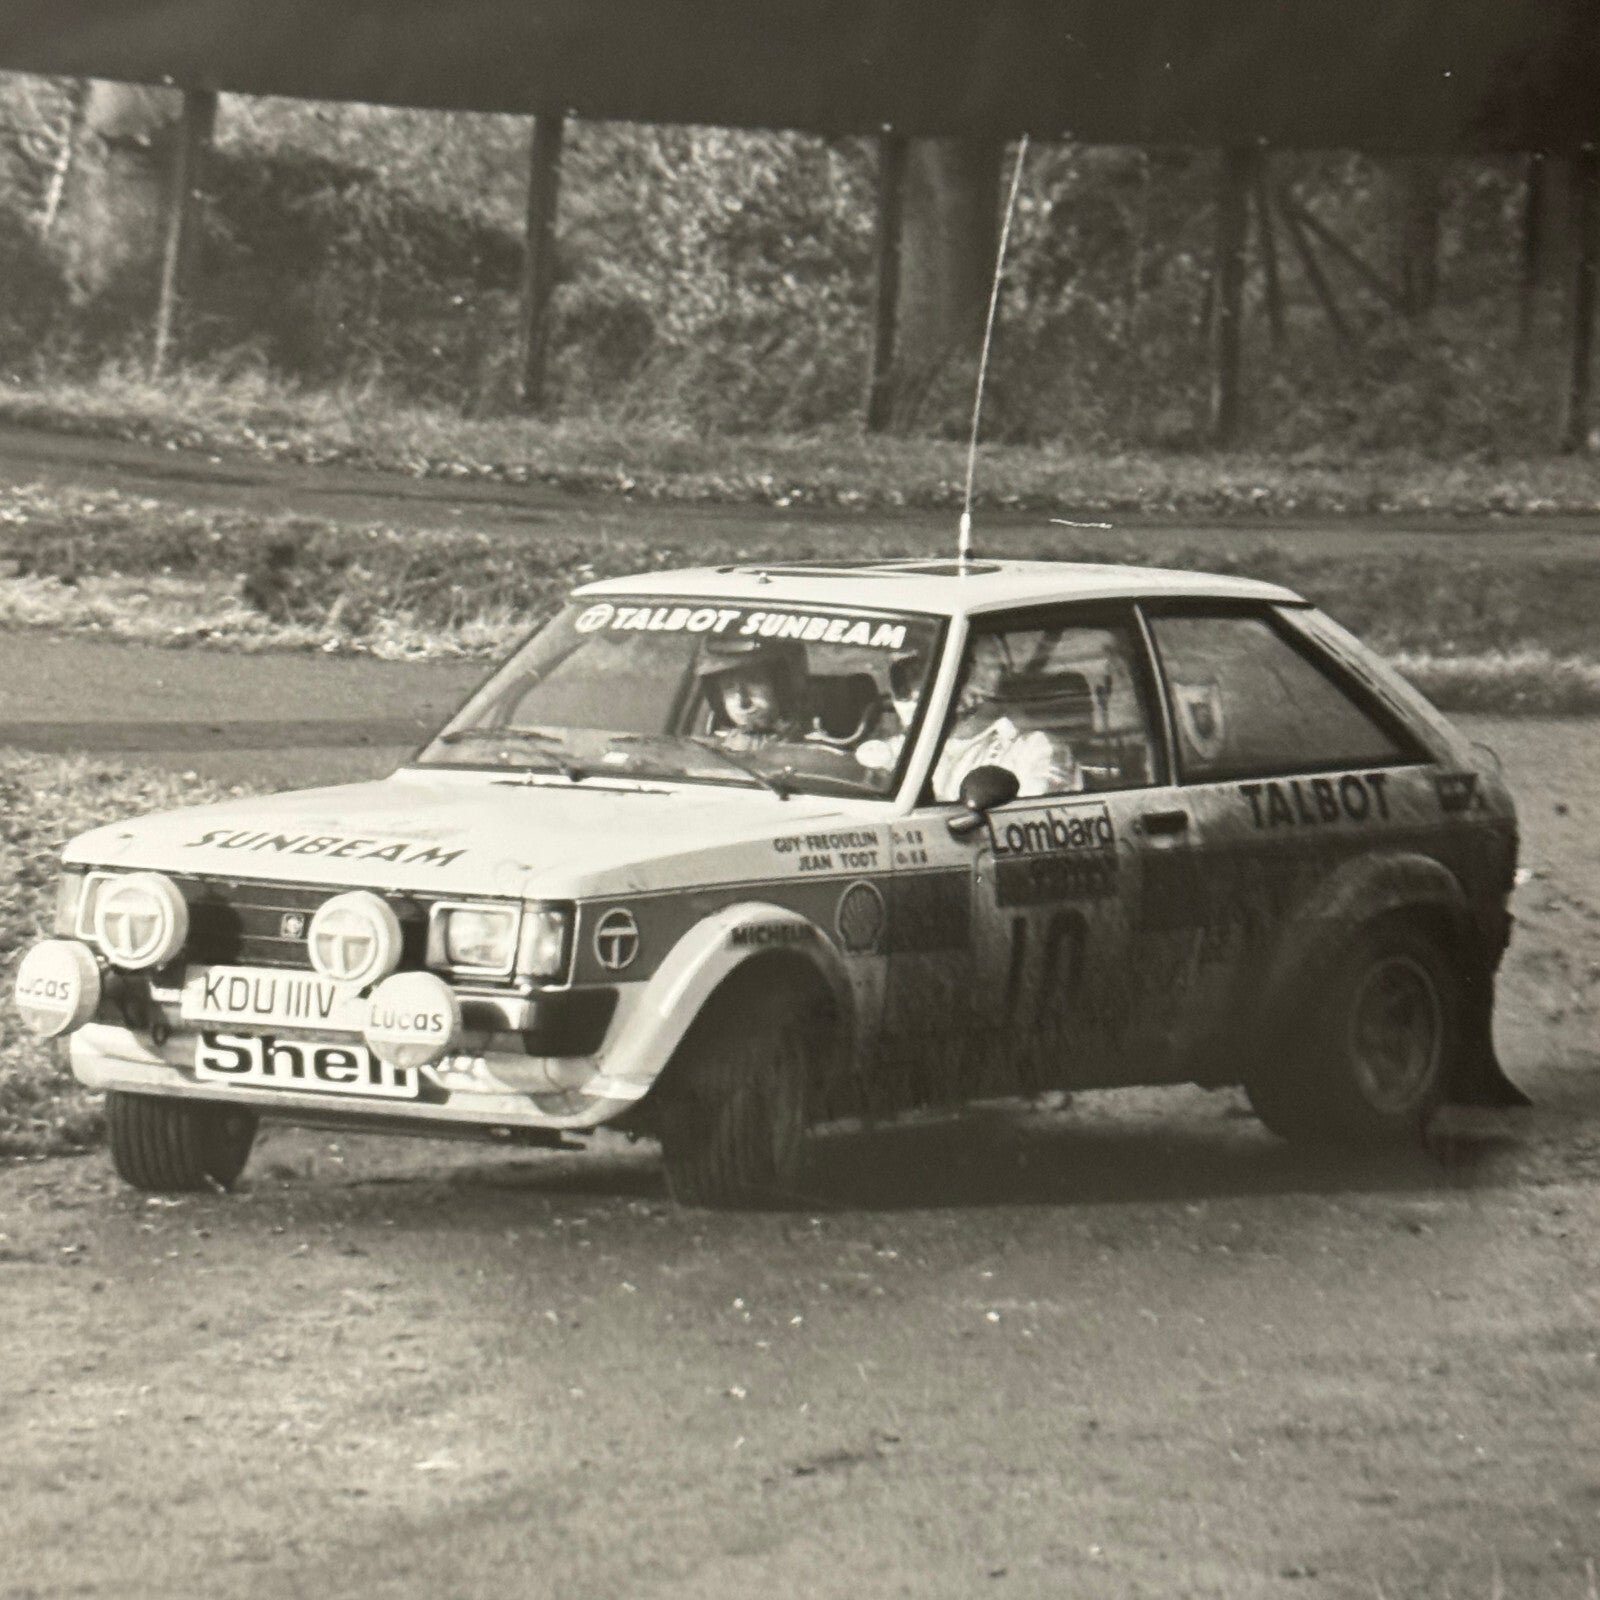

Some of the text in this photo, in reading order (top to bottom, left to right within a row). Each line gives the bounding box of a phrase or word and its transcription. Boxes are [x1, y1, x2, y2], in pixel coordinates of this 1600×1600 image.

[611, 607, 906, 648] TALBOT SUNBEAM
[1239, 774, 1390, 829] TALBOT
[185, 830, 468, 867] SUNBEAM
[989, 808, 1113, 851] Lombard
